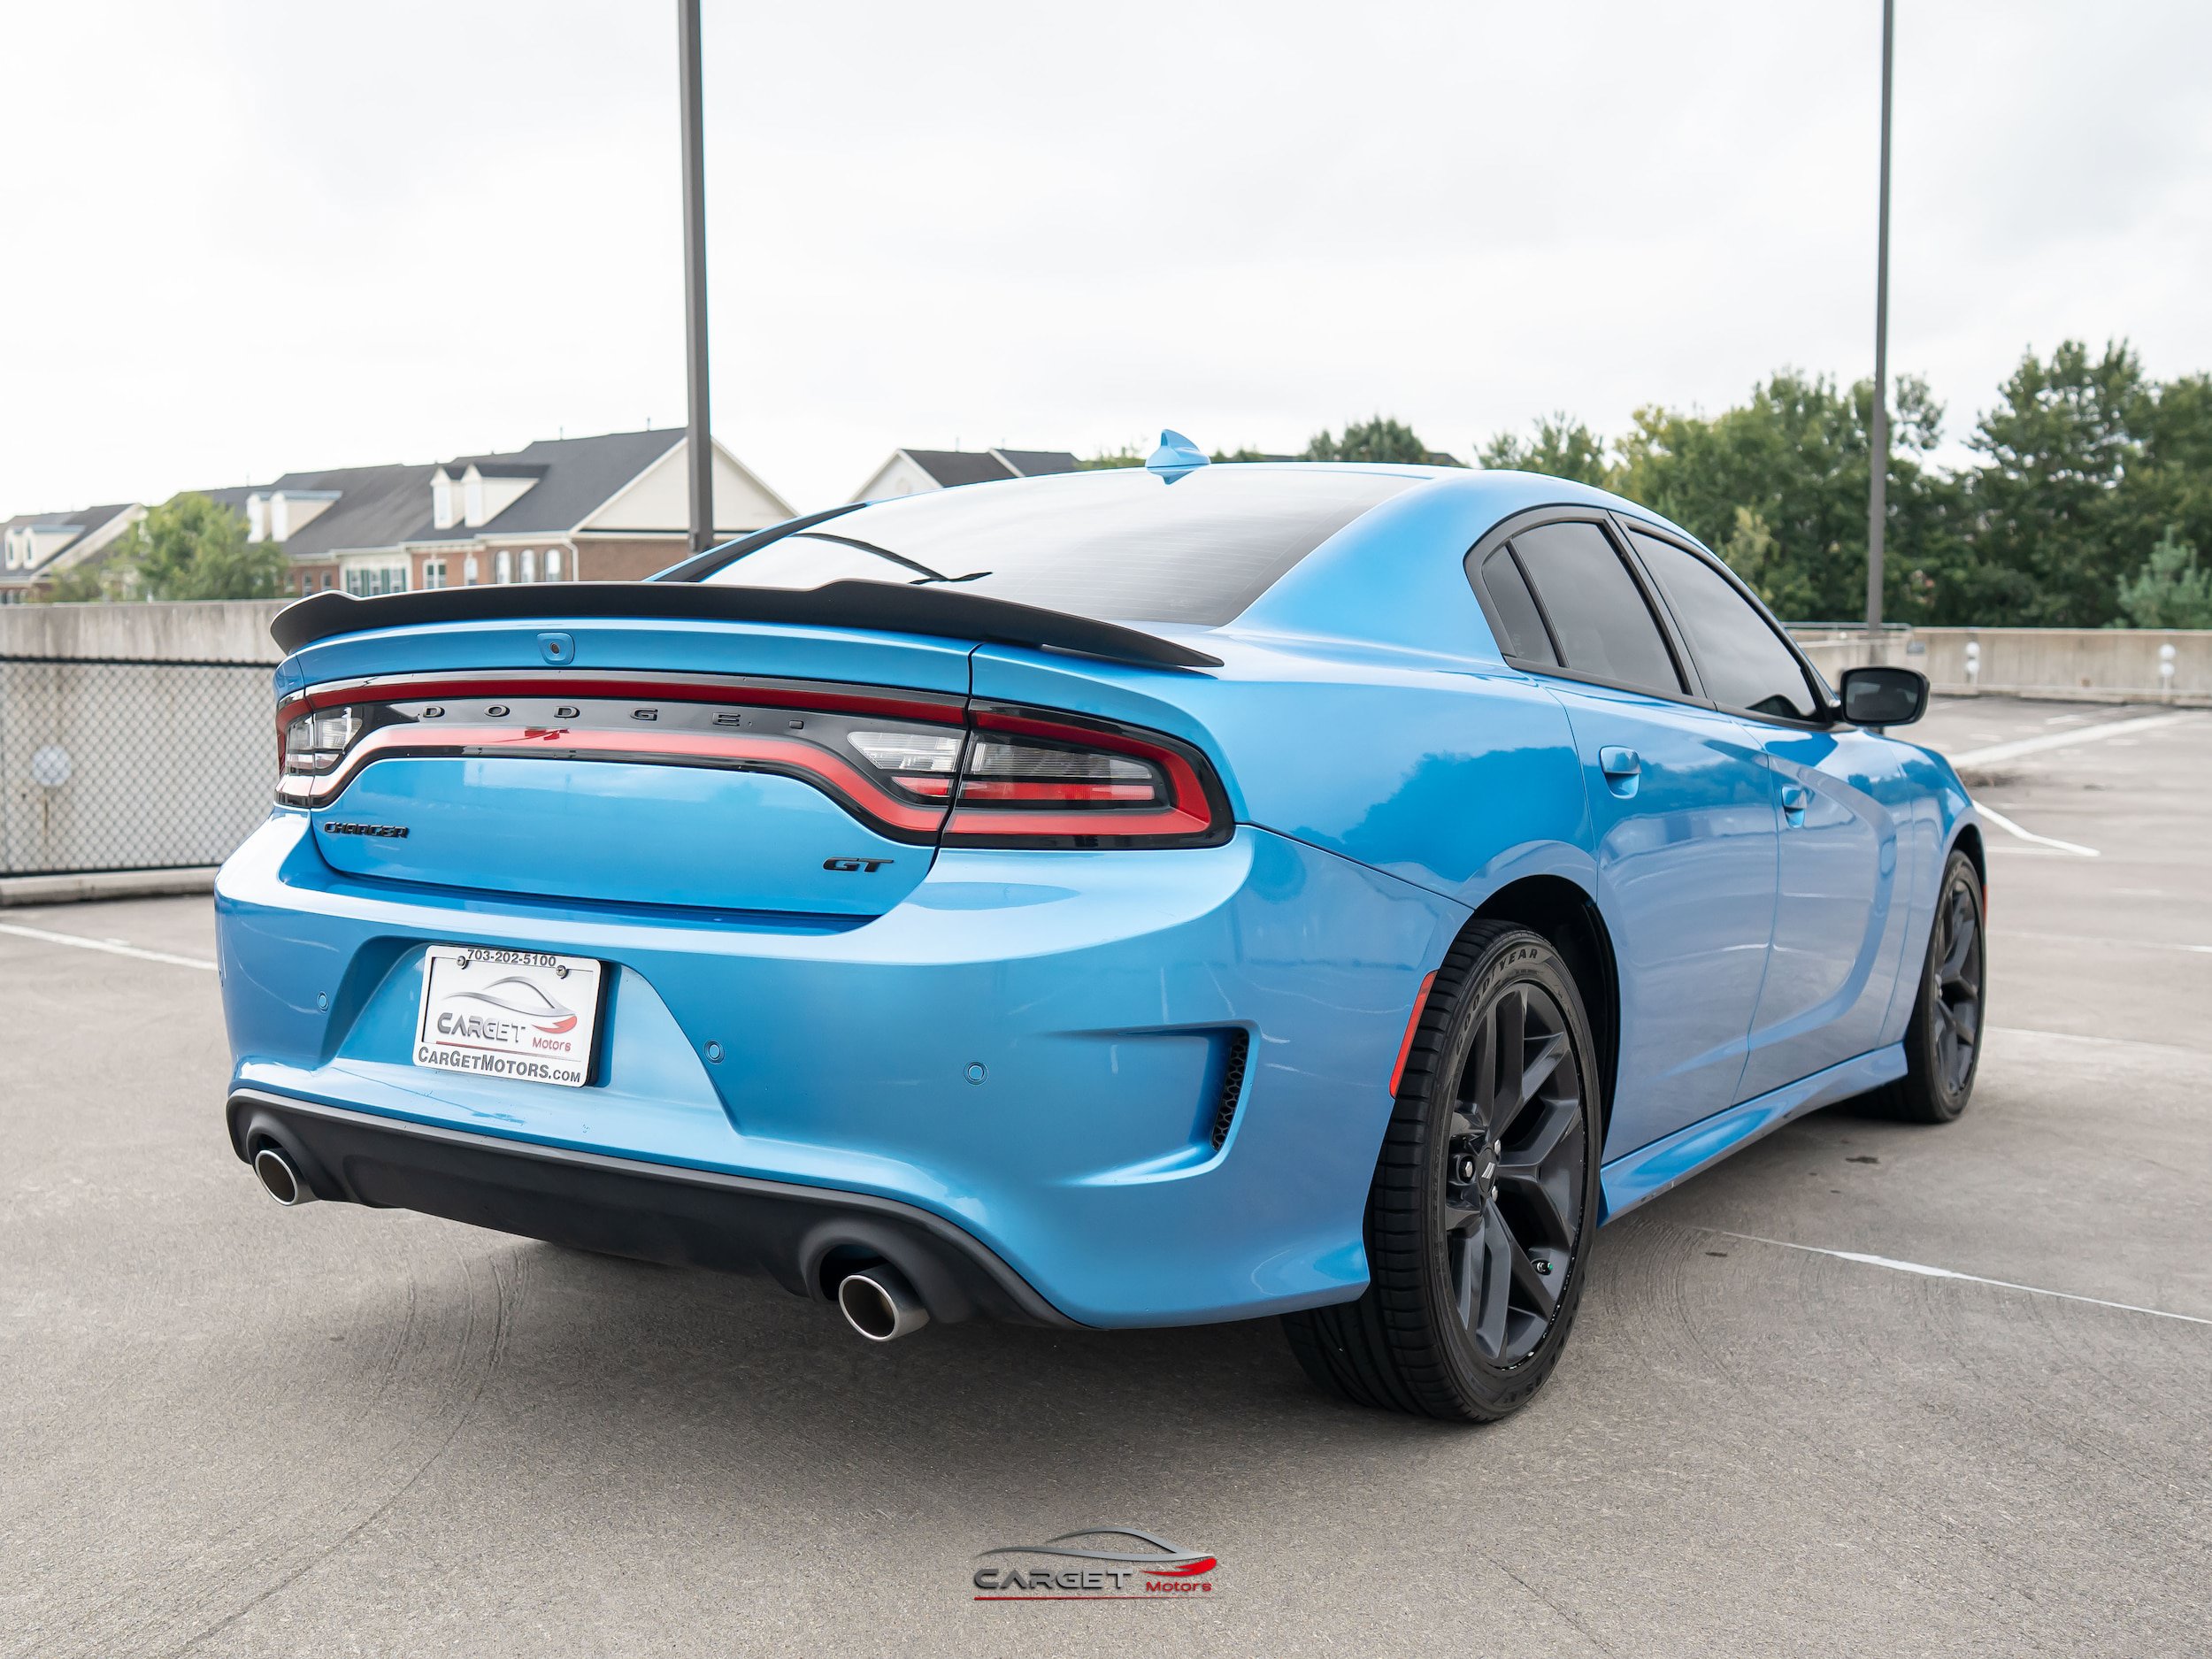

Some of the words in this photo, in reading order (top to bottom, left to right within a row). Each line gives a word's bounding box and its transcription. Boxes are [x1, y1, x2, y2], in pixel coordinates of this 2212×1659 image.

[423, 704, 741, 727] DODGE
[324, 821, 410, 839] CHARGER
[823, 856, 895, 873] GT
[466, 949, 557, 968] 703-202-5100
[437, 1012, 526, 1043] CARGET
[532, 1036, 572, 1052] Motors
